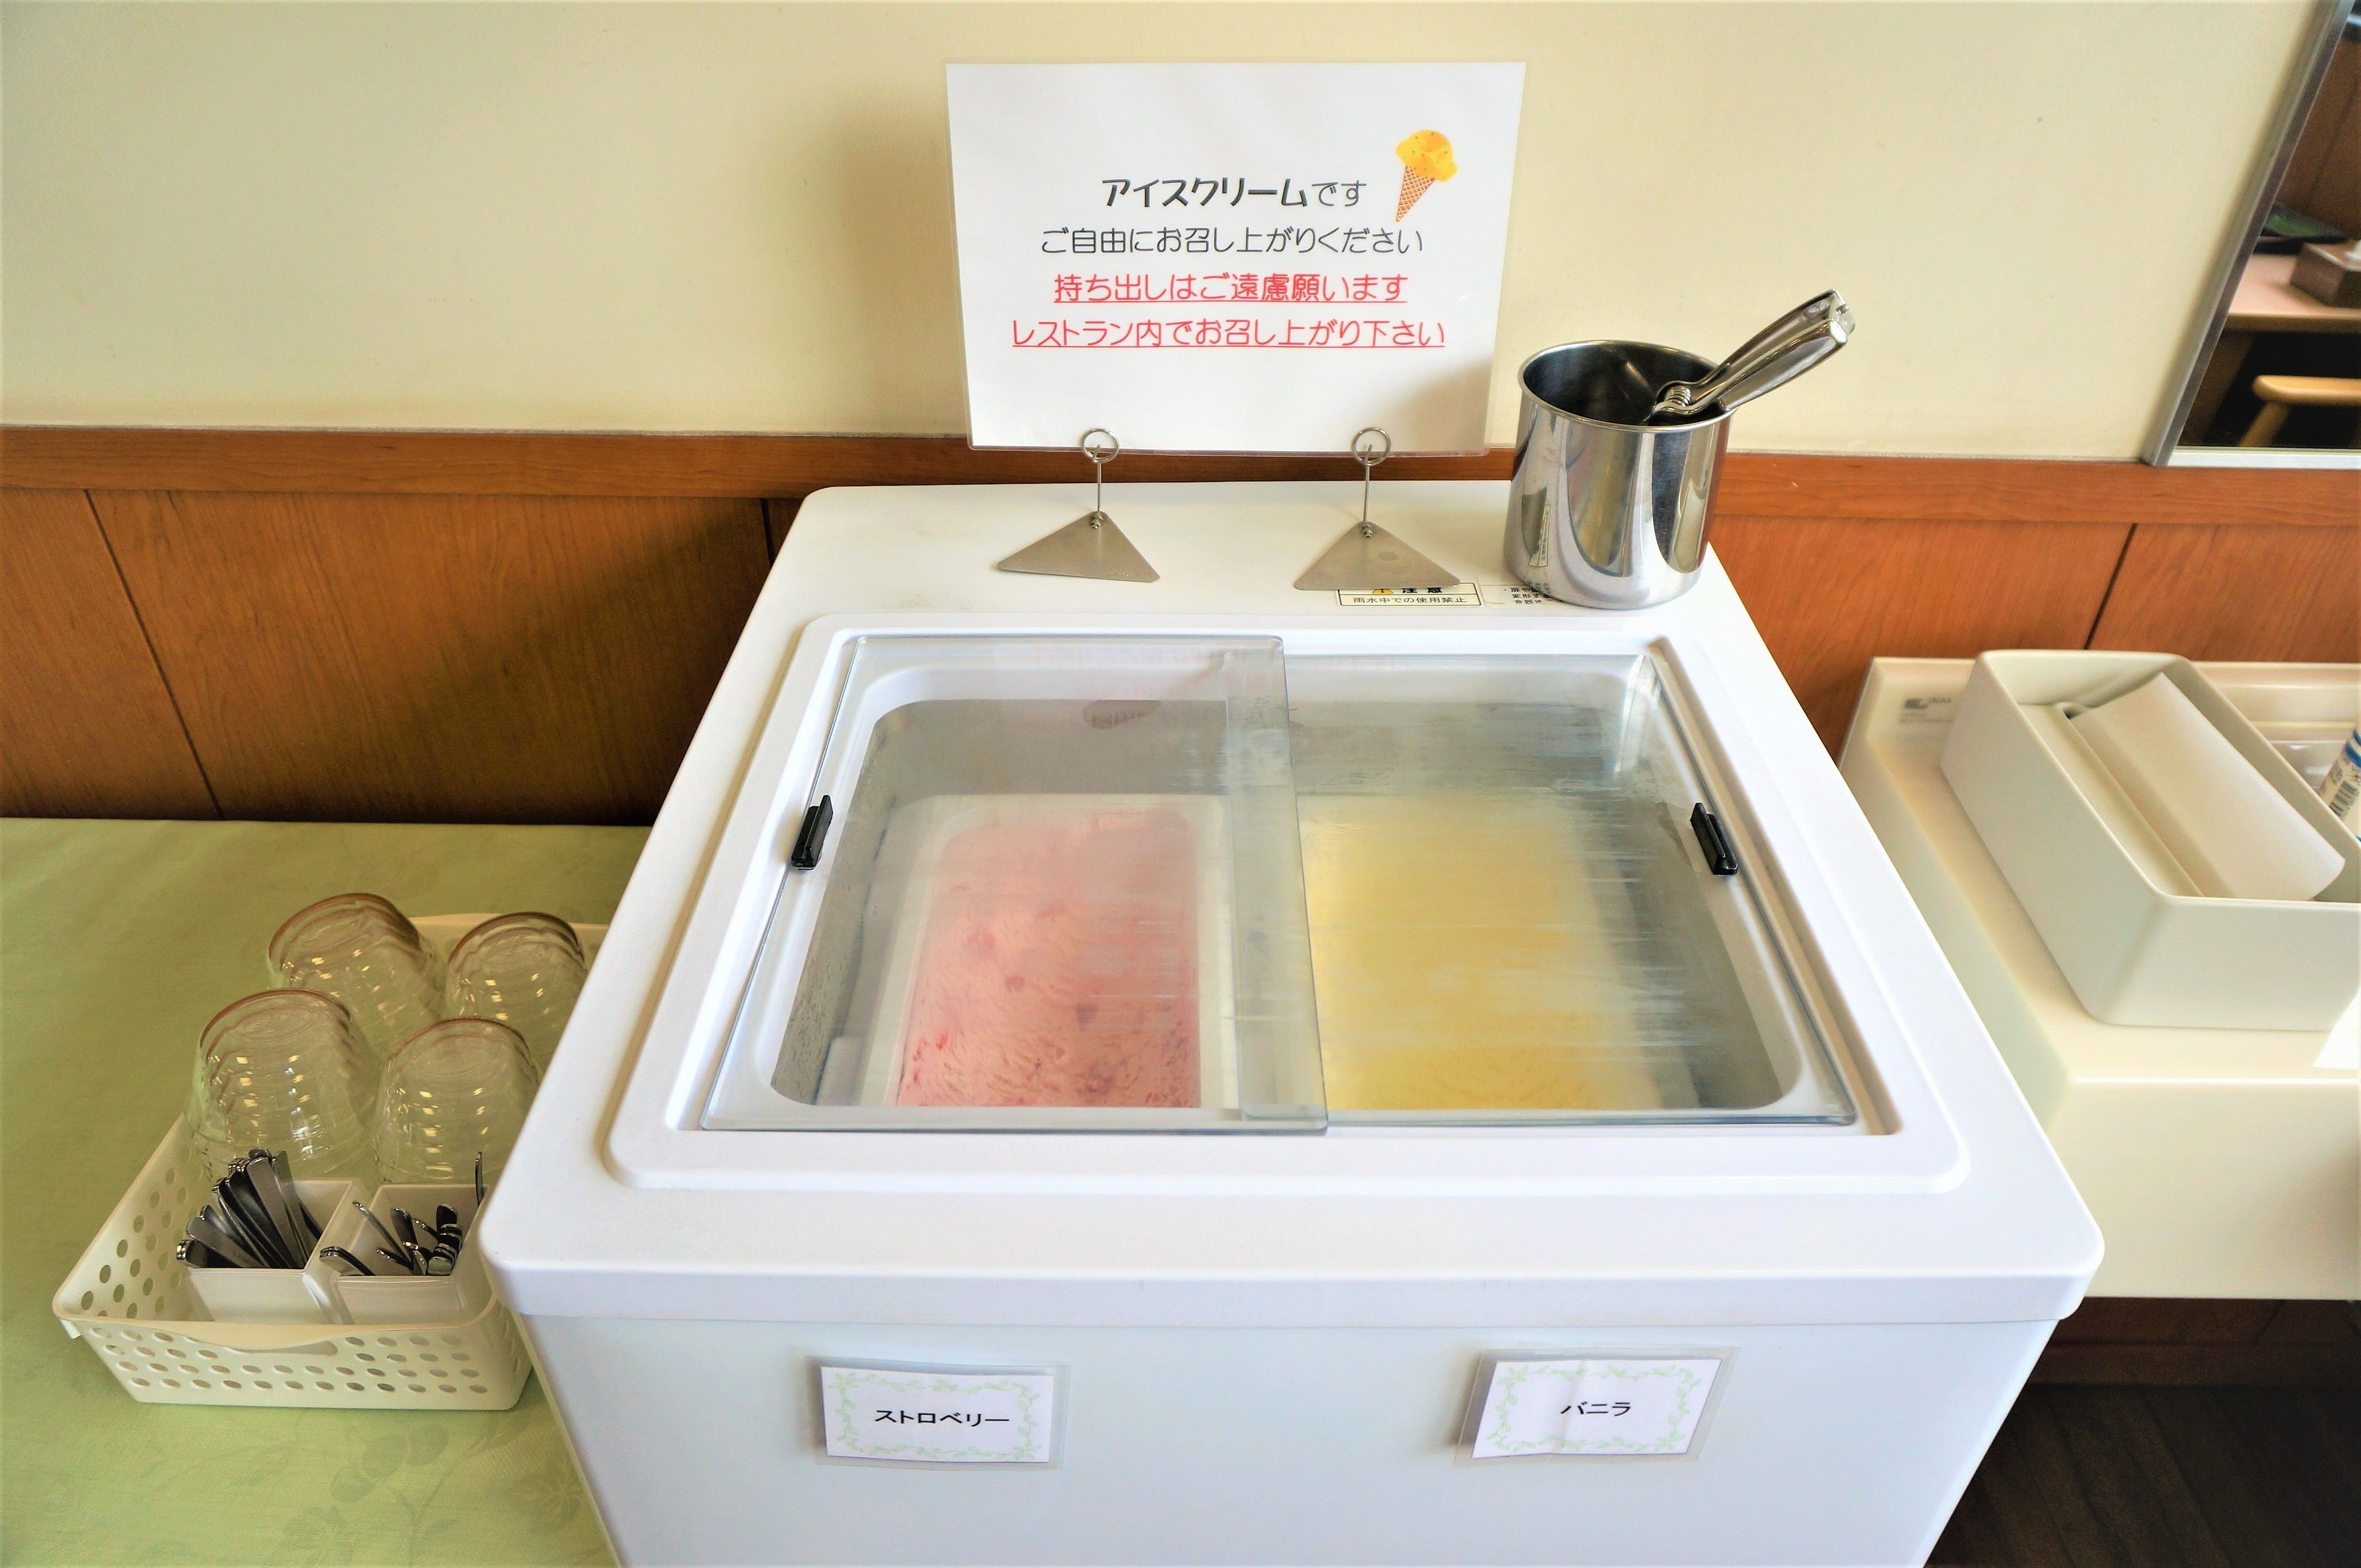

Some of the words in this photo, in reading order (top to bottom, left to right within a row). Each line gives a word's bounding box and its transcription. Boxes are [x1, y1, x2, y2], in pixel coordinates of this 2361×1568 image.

[1102, 177, 1367, 208] アイスクリームです
[1042, 226, 1422, 254] ご自由にお召し上がりください
[1054, 272, 1408, 303] 持ち出しはご遠慮願います
[1013, 318, 1444, 348] レストラン内でお召し上がり下さい
[874, 1409, 1009, 1427] ストロベリー
[1560, 1401, 1631, 1416] バニラ
